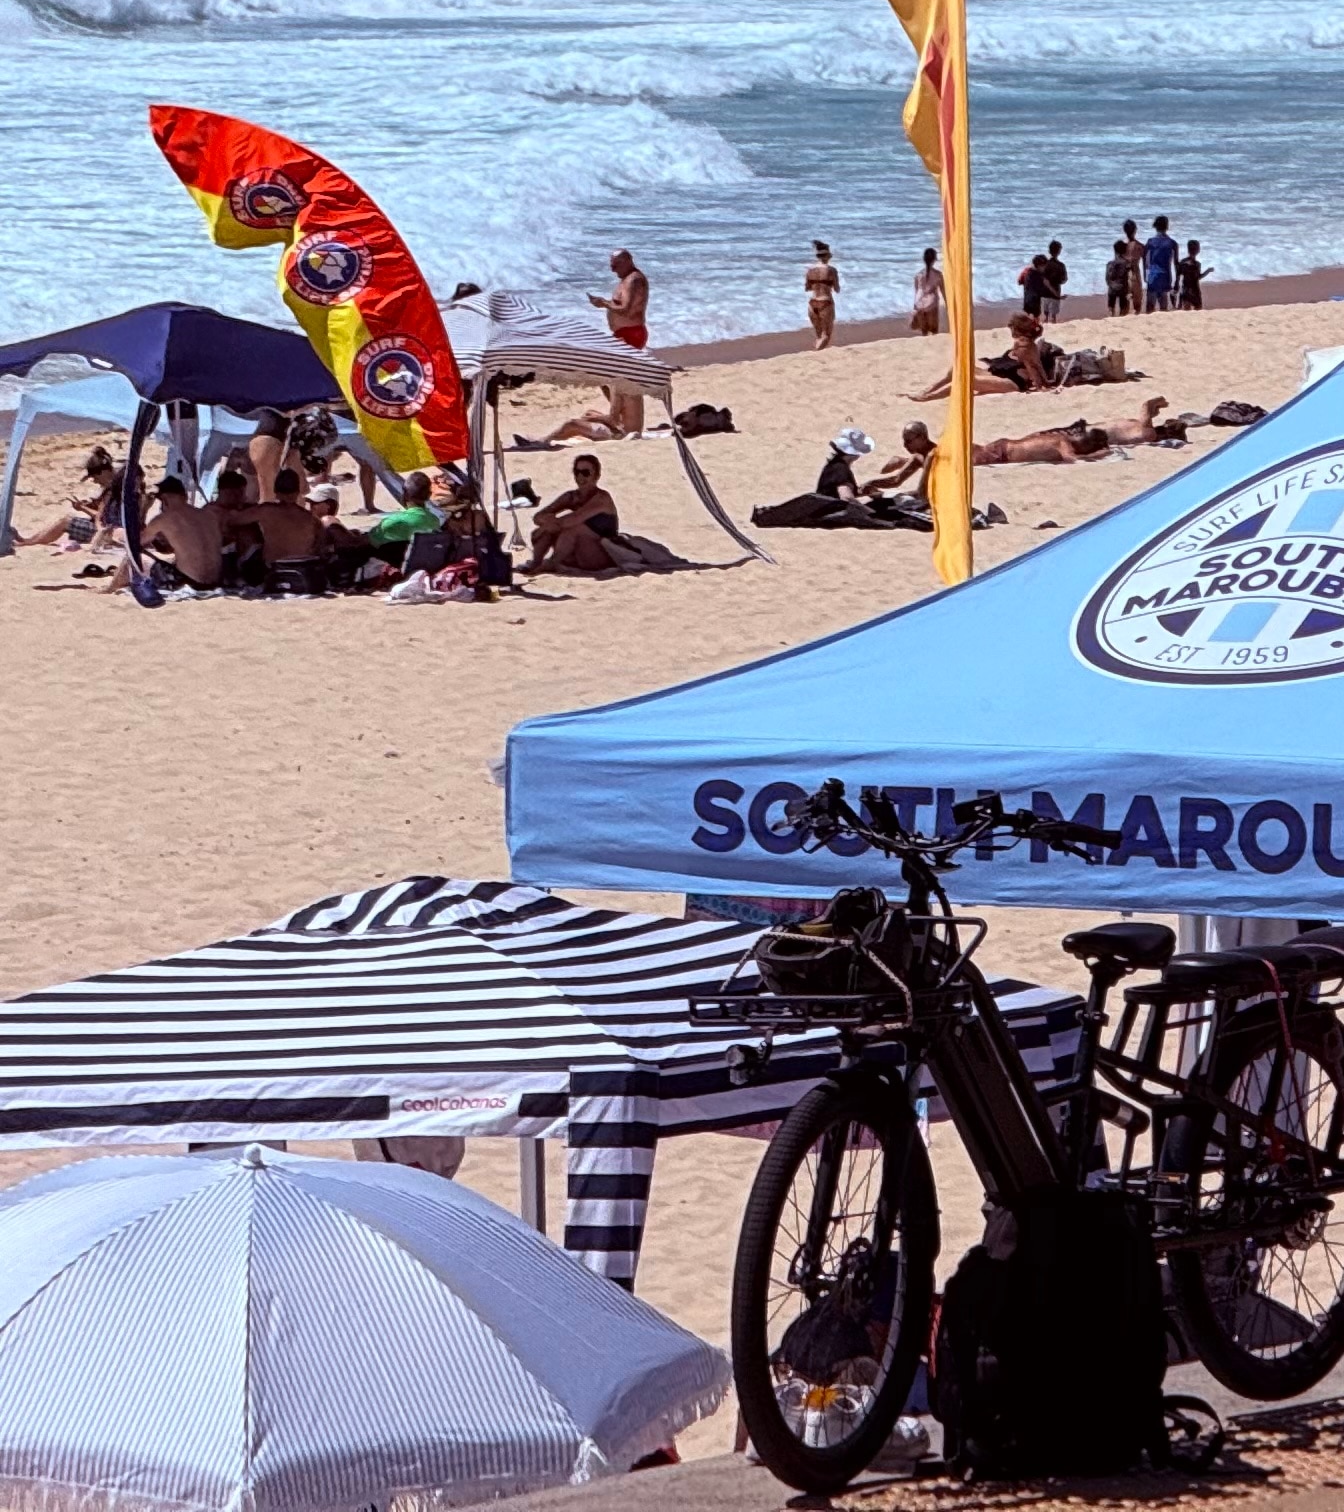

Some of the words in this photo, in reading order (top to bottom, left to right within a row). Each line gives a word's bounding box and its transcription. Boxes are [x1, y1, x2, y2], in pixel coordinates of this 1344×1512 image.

[357, 337, 407, 365] SURF
[1173, 503, 1243, 553] SURF
[1256, 469, 1318, 506] LIFE
[1155, 643, 1204, 662] EST
[1221, 645, 1289, 666] 1959
[401, 1096, 507, 1113] coolcabanas
